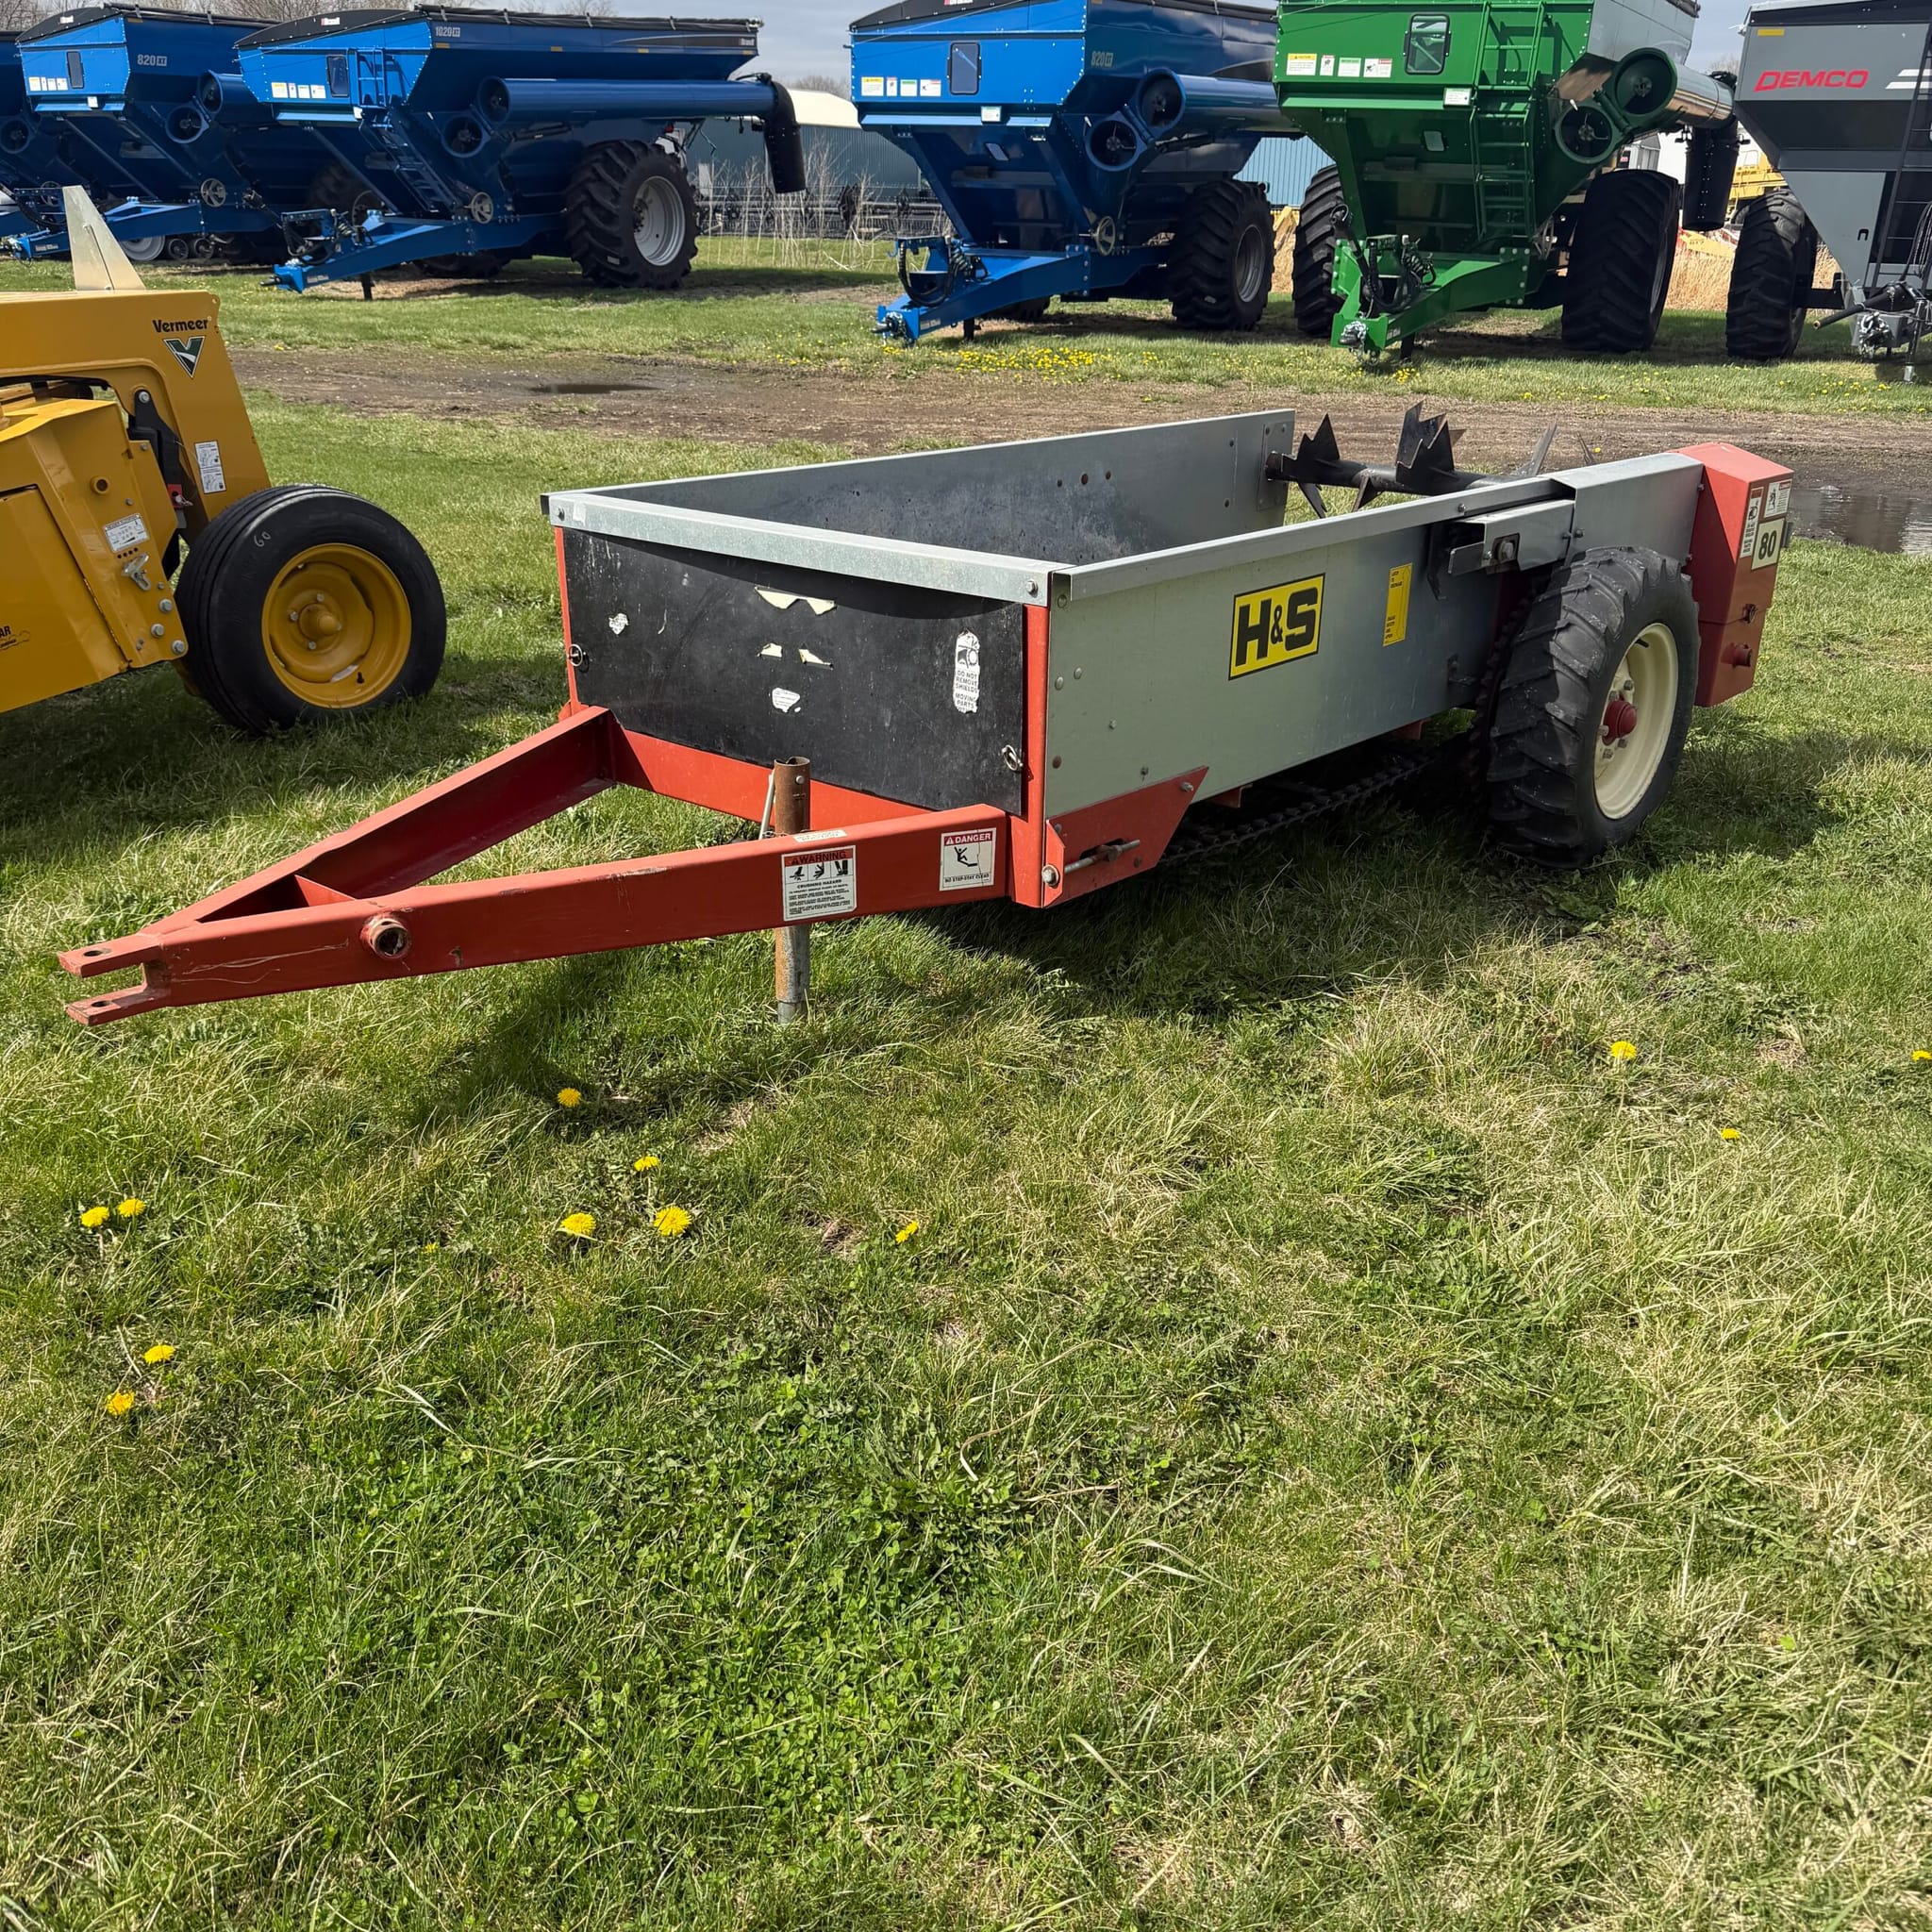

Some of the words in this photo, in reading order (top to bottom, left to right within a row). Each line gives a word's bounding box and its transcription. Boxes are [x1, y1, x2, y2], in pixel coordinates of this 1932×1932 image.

[1753, 69, 1869, 92] DEMCO
[152, 319, 208, 333] Vermeer
[1757, 530, 1777, 560] 80
[1235, 587, 1319, 667] H&S
[956, 675, 977, 686] REMOVE
[966, 672, 977, 680] NOT
[955, 833, 991, 844] DANGER
[799, 850, 846, 864] WARNING
